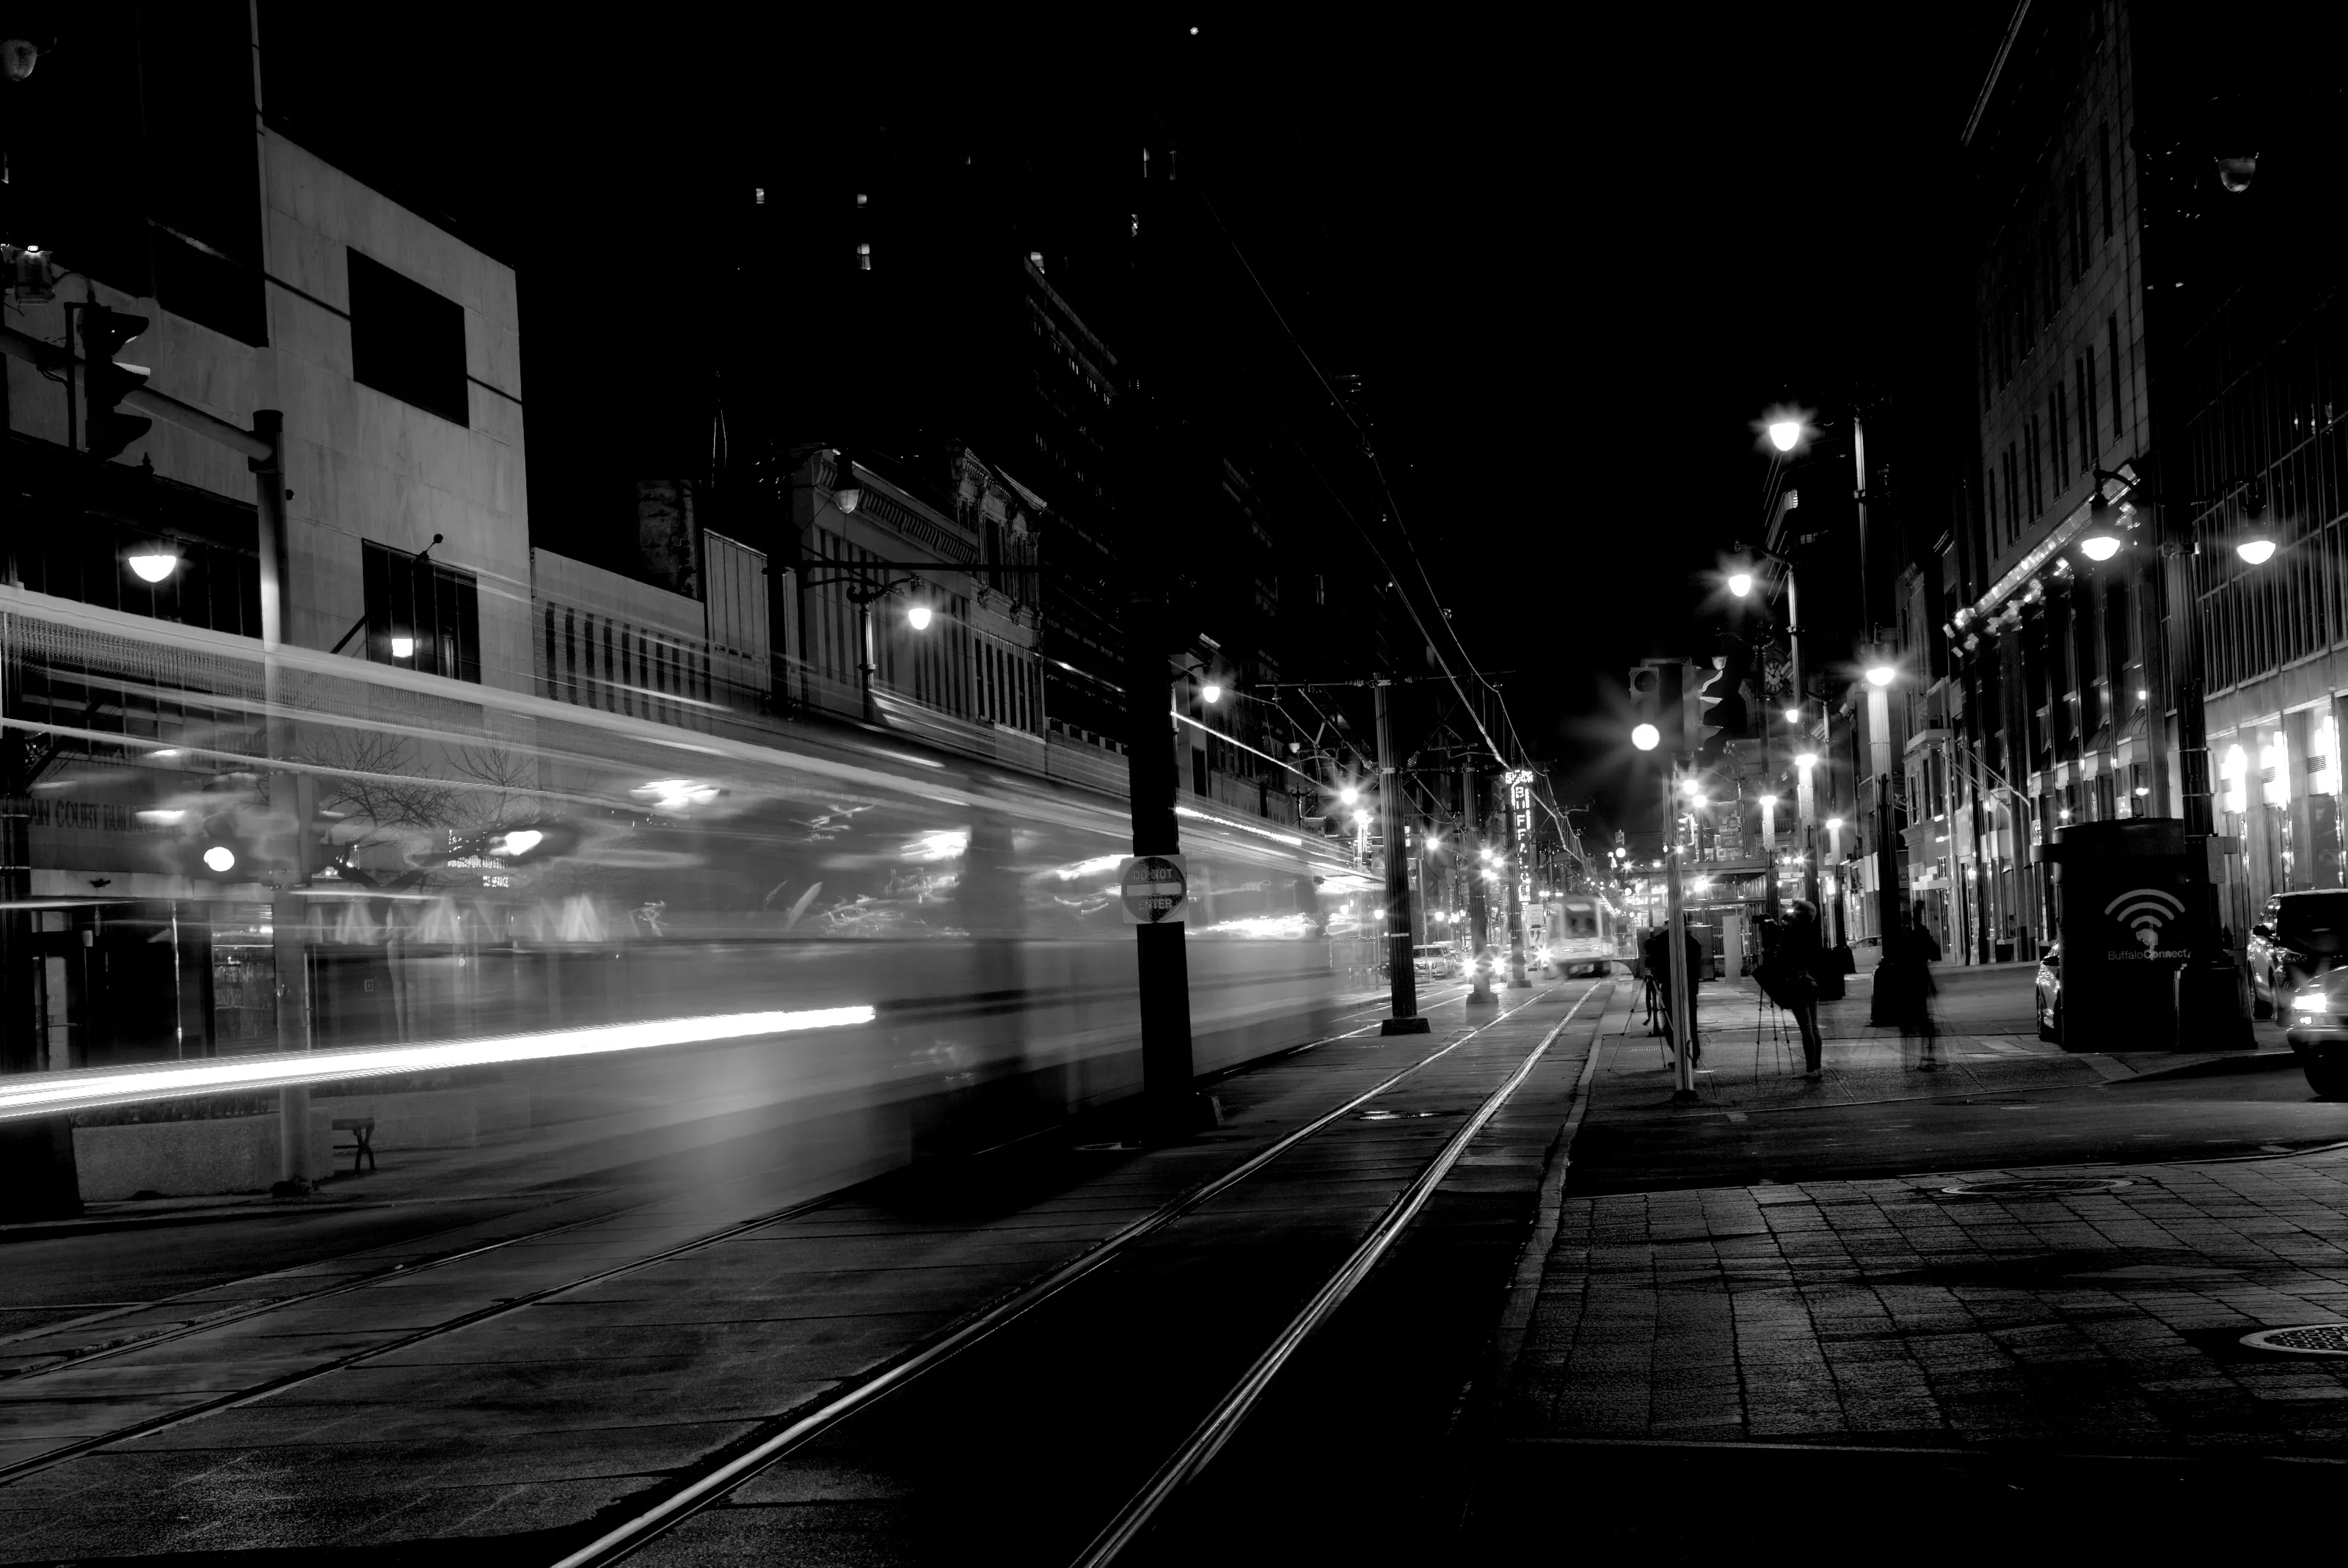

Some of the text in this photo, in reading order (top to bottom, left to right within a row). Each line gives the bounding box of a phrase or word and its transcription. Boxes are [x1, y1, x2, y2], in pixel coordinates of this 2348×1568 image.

[28, 798, 50, 826] AIN
[56, 800, 100, 830] COURT
[1134, 869, 1173, 880] DO NOT
[1138, 900, 1172, 910] ENTER
